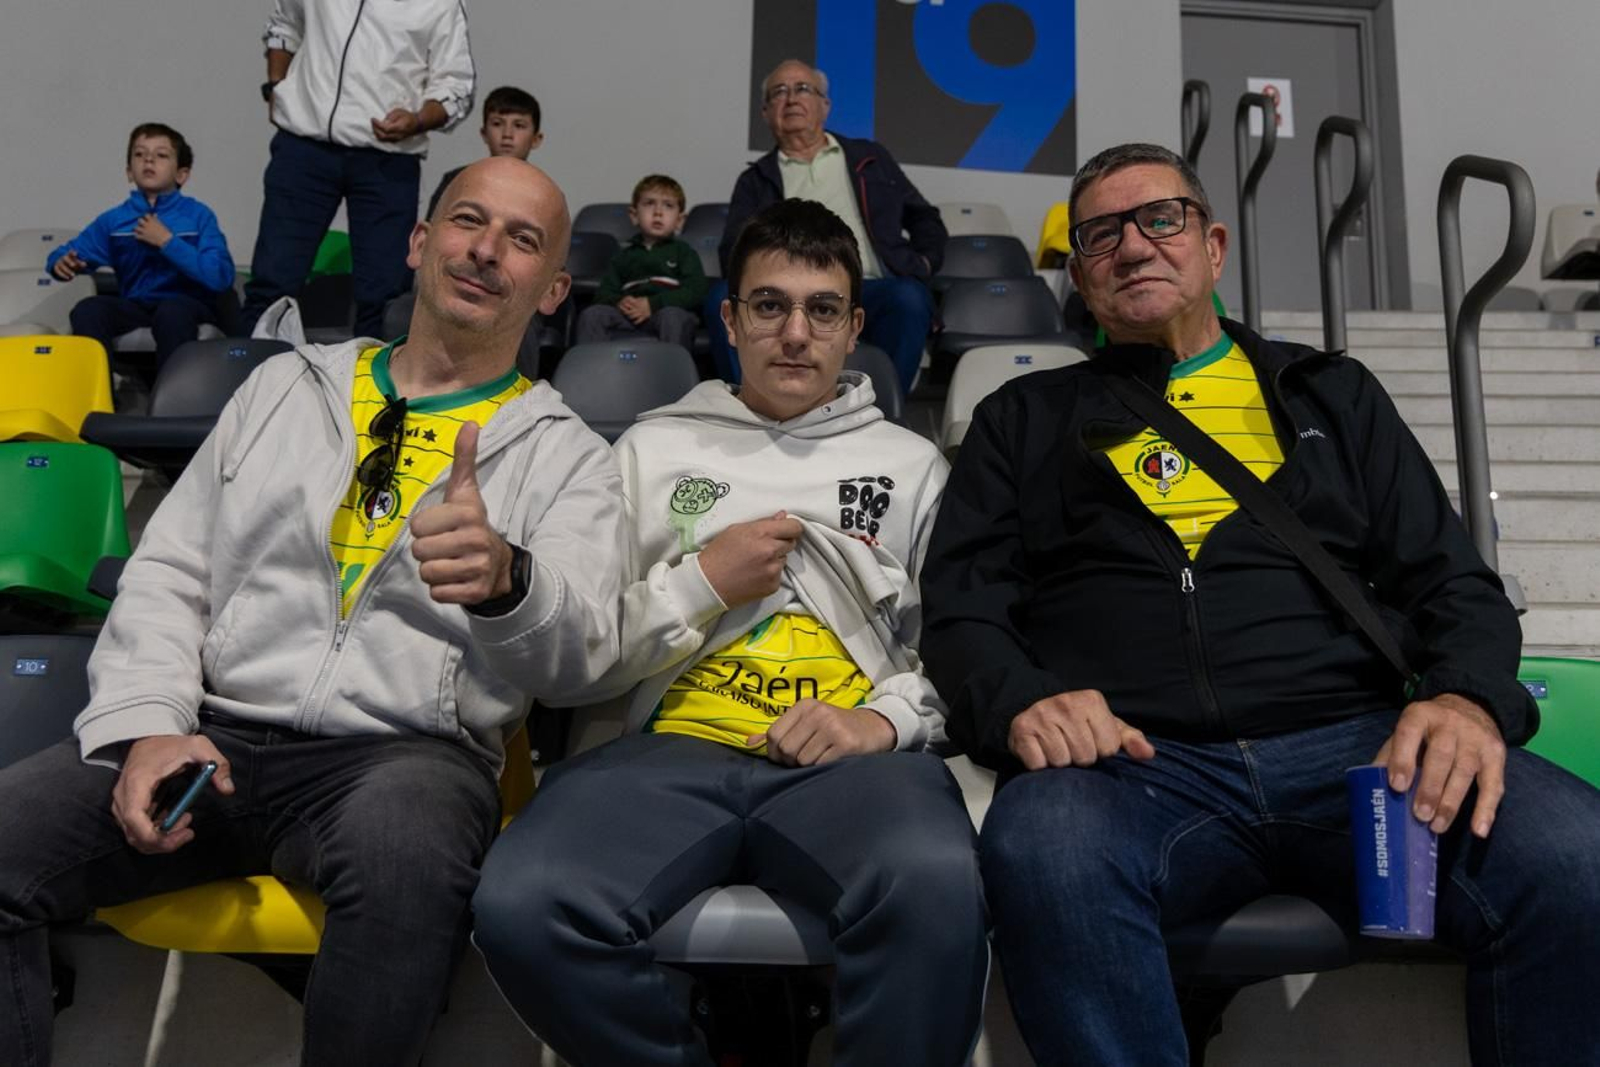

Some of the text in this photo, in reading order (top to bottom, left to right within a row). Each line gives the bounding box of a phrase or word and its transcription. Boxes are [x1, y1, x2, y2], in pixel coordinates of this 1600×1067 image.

[816, 0, 1076, 173] 19
[25, 661, 38, 673] 10
[1371, 788, 1389, 878] #SOMOSJAÉN
